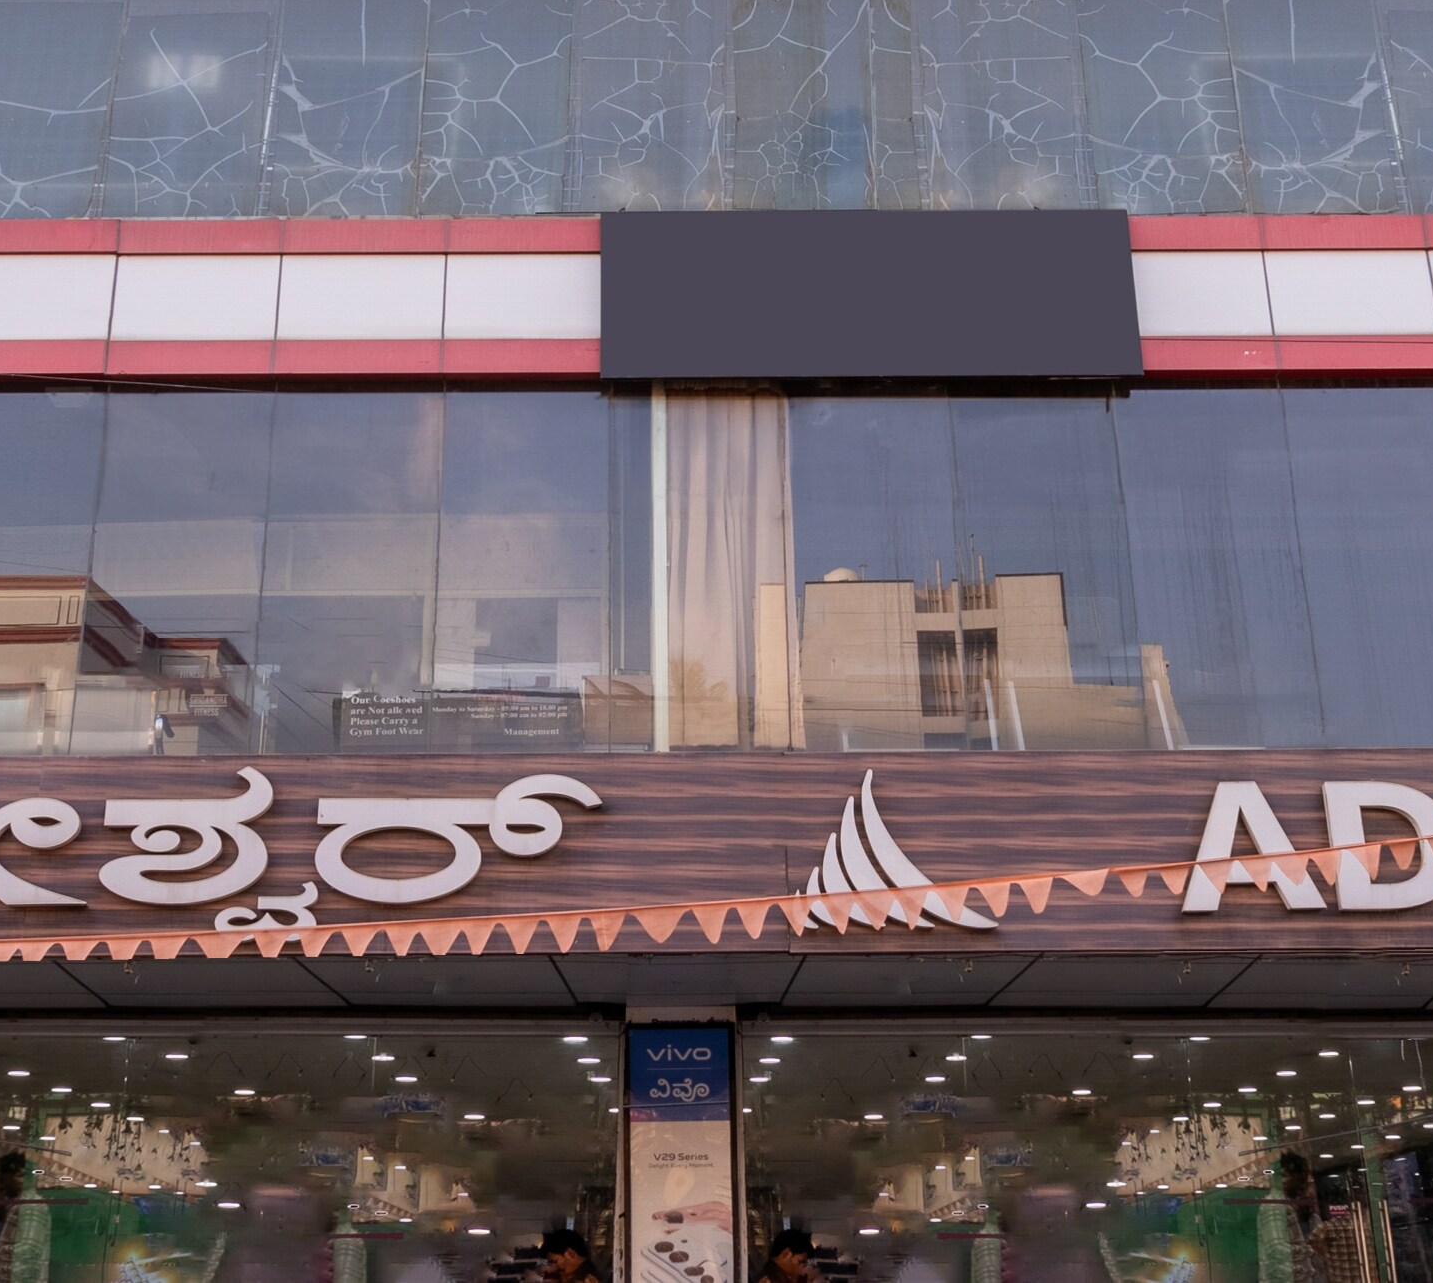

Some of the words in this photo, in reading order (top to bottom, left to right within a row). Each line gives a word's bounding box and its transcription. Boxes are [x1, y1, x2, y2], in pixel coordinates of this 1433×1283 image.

[351, 695, 370, 704] Our
[350, 707, 366, 715] are
[368, 706, 385, 715] Not
[350, 717, 379, 726] Please
[381, 716, 408, 727] Carry
[349, 727, 373, 738] Gym
[375, 727, 397, 736] Foot
[399, 727, 424, 736] Wear
[504, 727, 560, 737] Management
[647, 1044, 712, 1061] vivo
[653, 1153, 676, 1161] V29
[678, 1152, 709, 1161] Series
